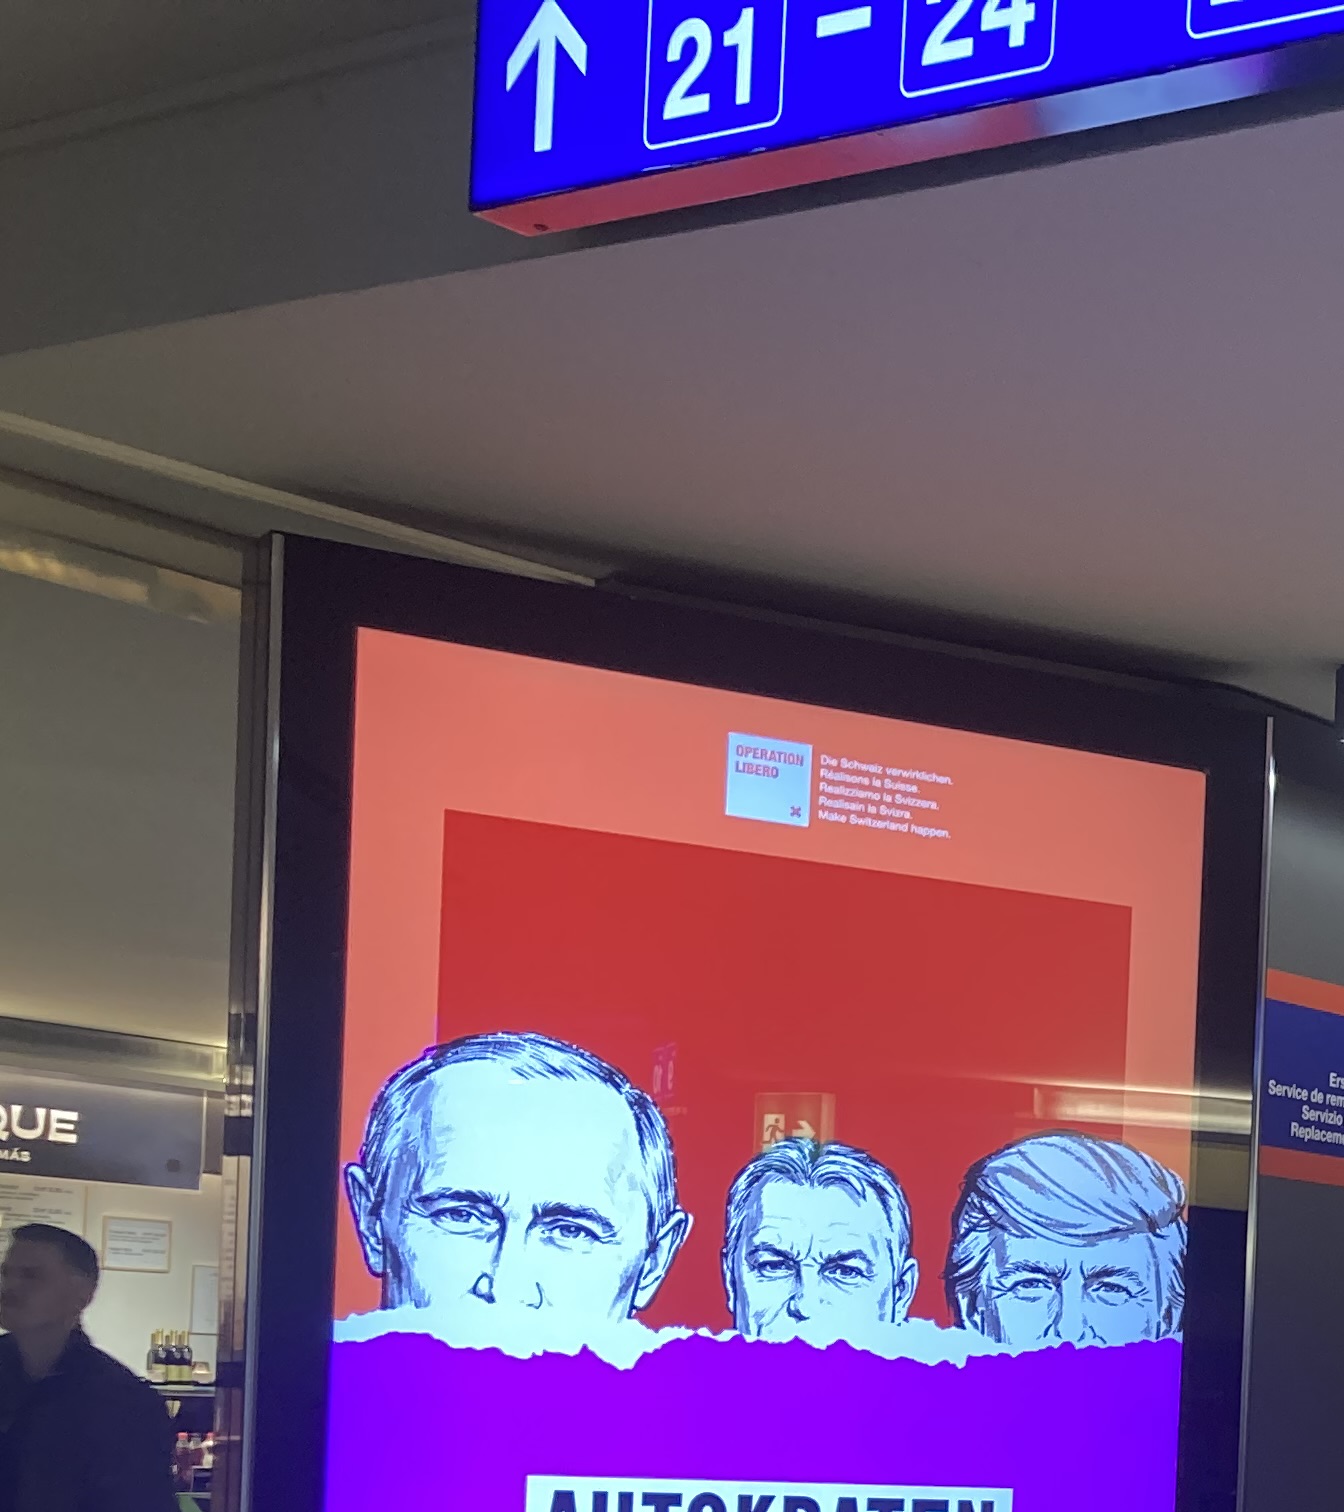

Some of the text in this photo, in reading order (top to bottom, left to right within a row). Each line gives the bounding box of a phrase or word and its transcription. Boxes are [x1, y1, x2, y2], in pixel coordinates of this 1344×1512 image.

[663, 6, 754, 120] 21
[736, 744, 804, 767] OPERATION
[820, 754, 838, 767] Die
[840, 758, 883, 775] Schweiz
[735, 760, 779, 779] LIBERO
[818, 809, 952, 839] Make Switzerland happen.
[1268, 1079, 1308, 1101] Service
[1310, 1087, 1324, 1104] de
[0, 1105, 78, 1143] UE
[1301, 1104, 1343, 1126] Servizio
